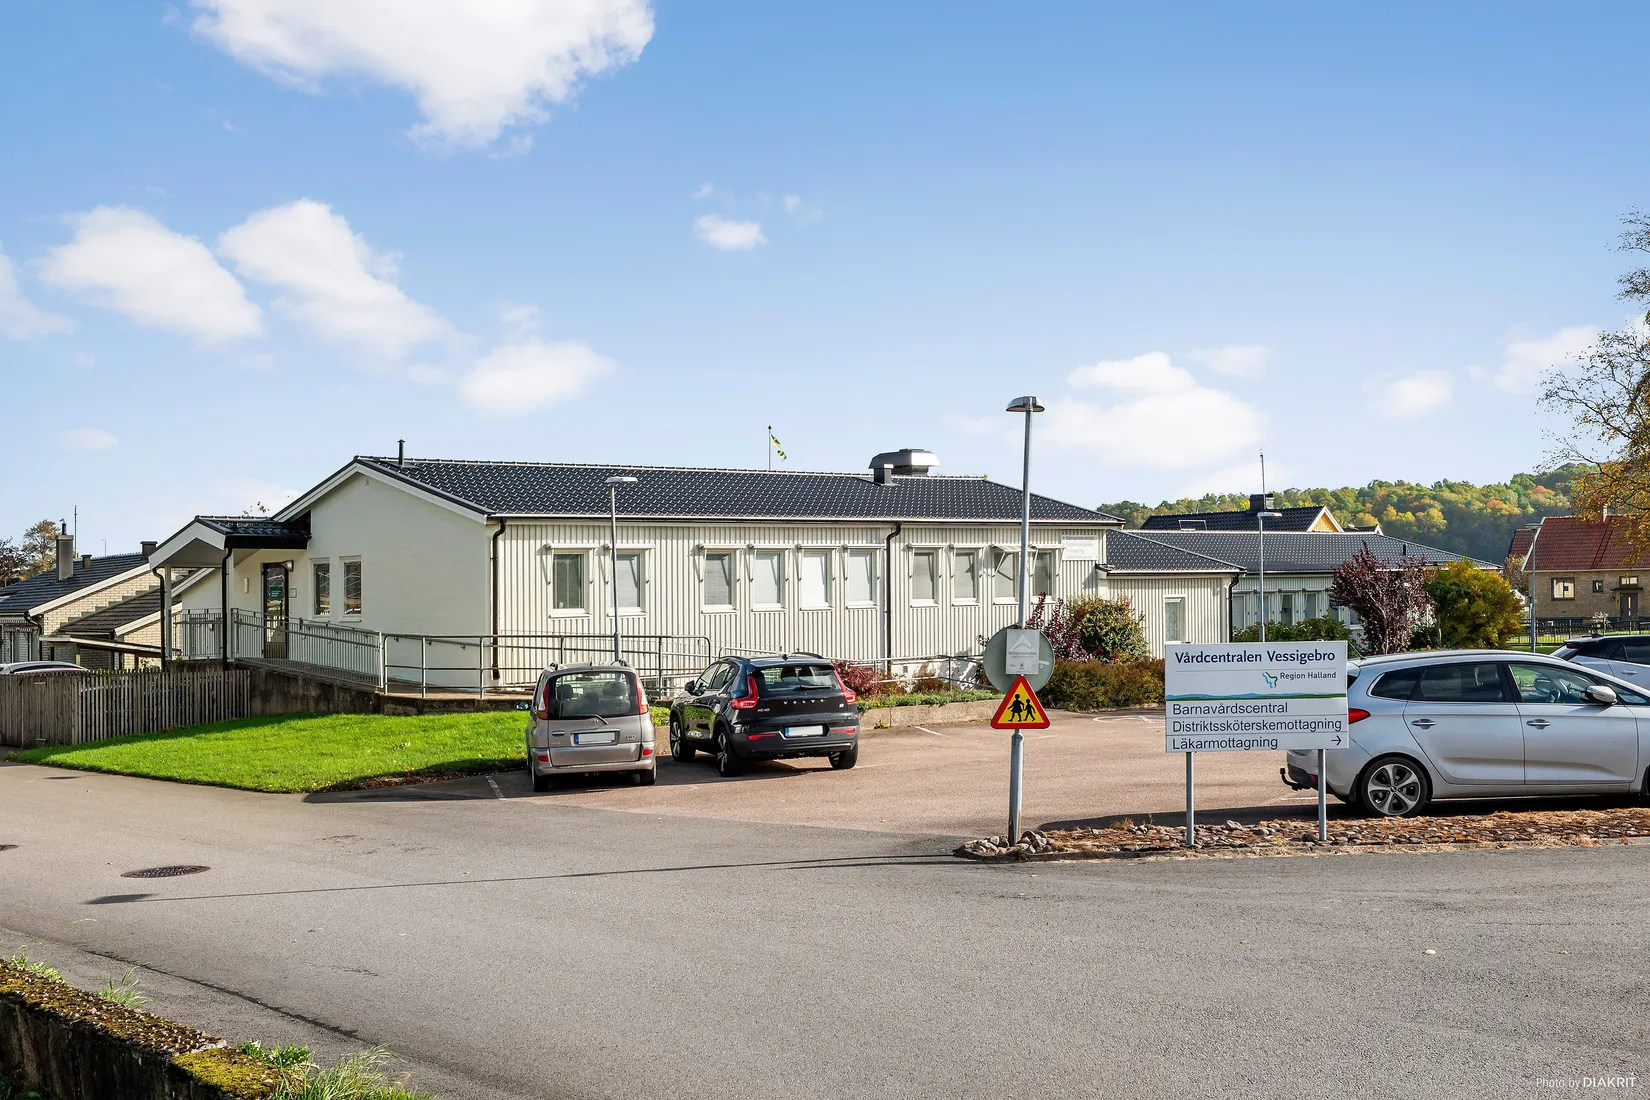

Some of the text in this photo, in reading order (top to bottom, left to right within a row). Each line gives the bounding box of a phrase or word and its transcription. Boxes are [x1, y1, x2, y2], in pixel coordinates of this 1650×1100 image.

[1175, 649, 1336, 665] Vårdcentralen Vessigebro
[1280, 671, 1337, 681] Region Halland
[1173, 702, 1288, 716] Barnavårdscentral
[1173, 718, 1342, 733] Distriktssköterskemottagning
[1172, 736, 1279, 751] Läkarmottagning
